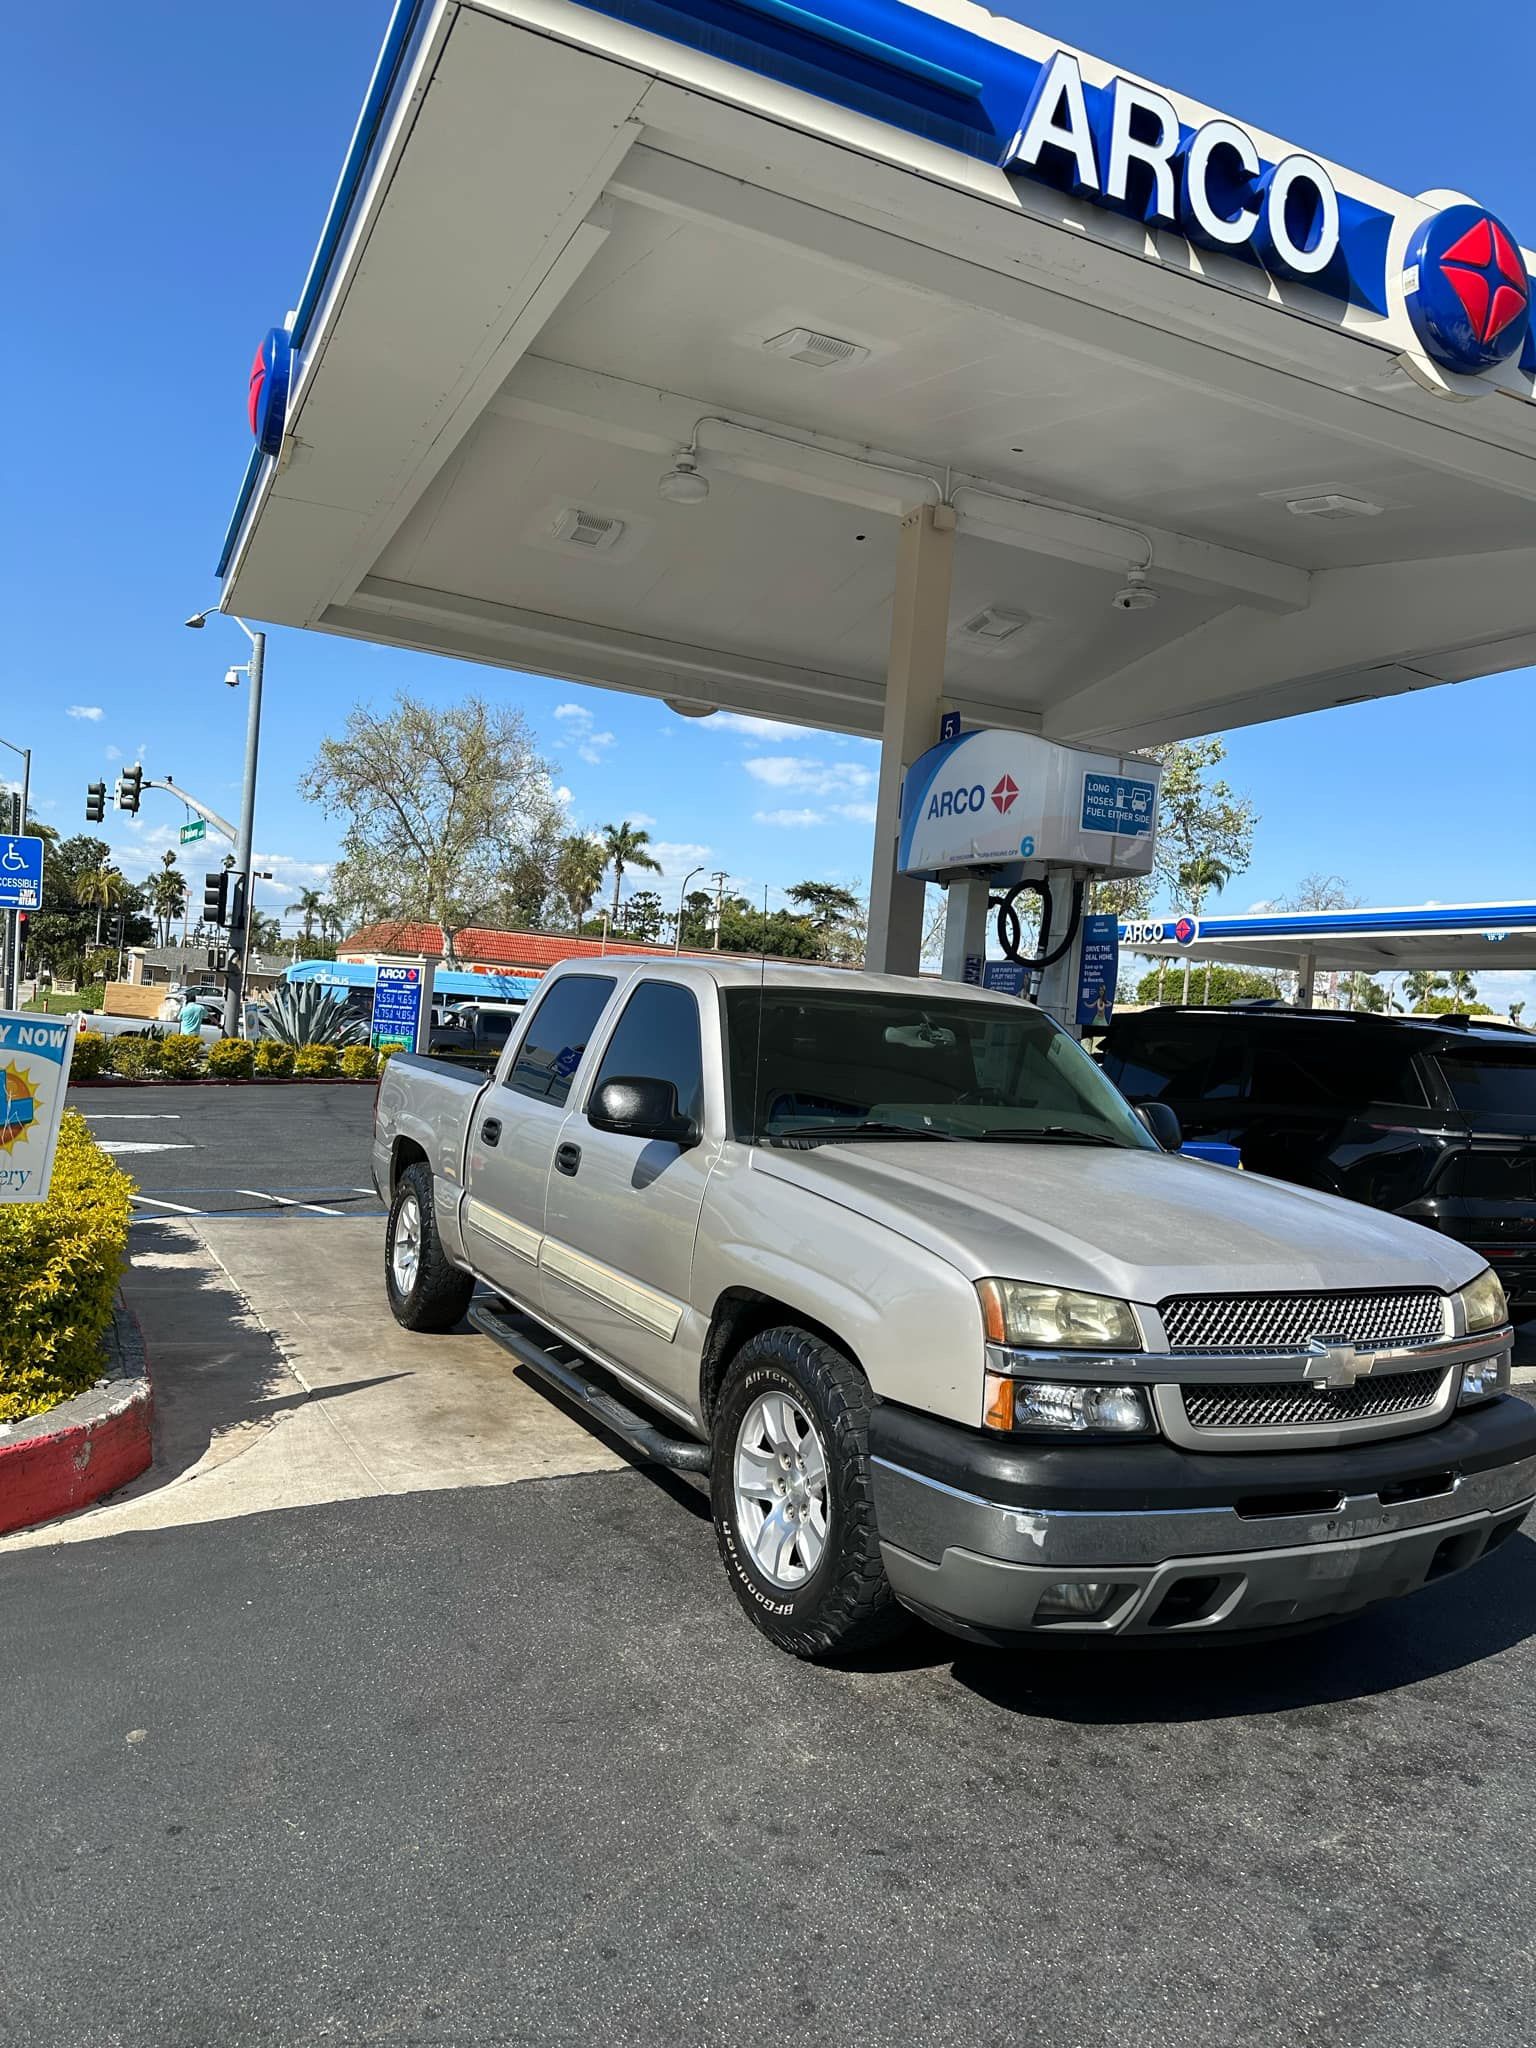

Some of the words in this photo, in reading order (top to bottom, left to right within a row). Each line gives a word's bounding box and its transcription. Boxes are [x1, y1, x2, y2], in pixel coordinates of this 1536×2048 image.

[1010, 50, 1340, 274] ARCO
[944, 719, 954, 739] 5
[1088, 783, 1110, 793] LONG
[928, 785, 985, 820] ARCO
[1087, 796, 1114, 806] HOSES
[1086, 807, 1106, 817] FUEL
[1107, 810, 1134, 821] EITHER
[1134, 814, 1151, 823] SIDE
[1020, 836, 1035, 858] 6
[1124, 923, 1164, 943] ARCO
[314, 973, 332, 984] OC
[332, 975, 349, 985] BUS
[379, 969, 406, 980] ARCO
[18, 1026, 66, 1048] NOW
[722, 1521, 794, 1615] BFGoodrich
